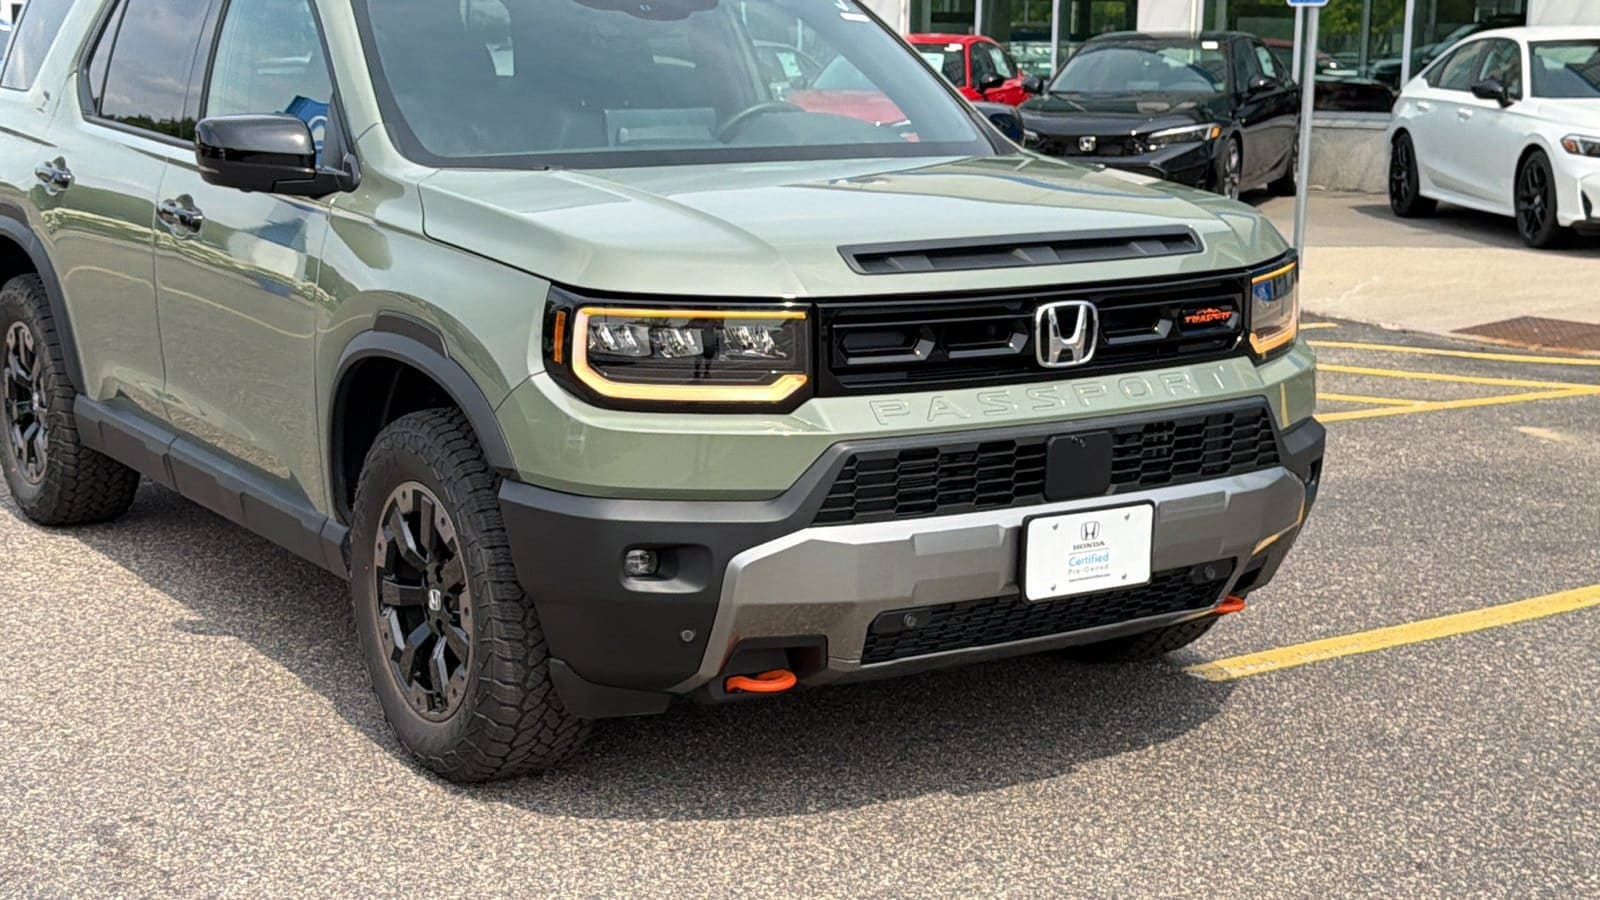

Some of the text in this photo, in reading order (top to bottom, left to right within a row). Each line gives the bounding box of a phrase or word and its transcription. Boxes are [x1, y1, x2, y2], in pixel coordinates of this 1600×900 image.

[868, 365, 1225, 426] PASSPORT
[1073, 541, 1105, 551] HONDA
[1069, 552, 1109, 566] Certified
